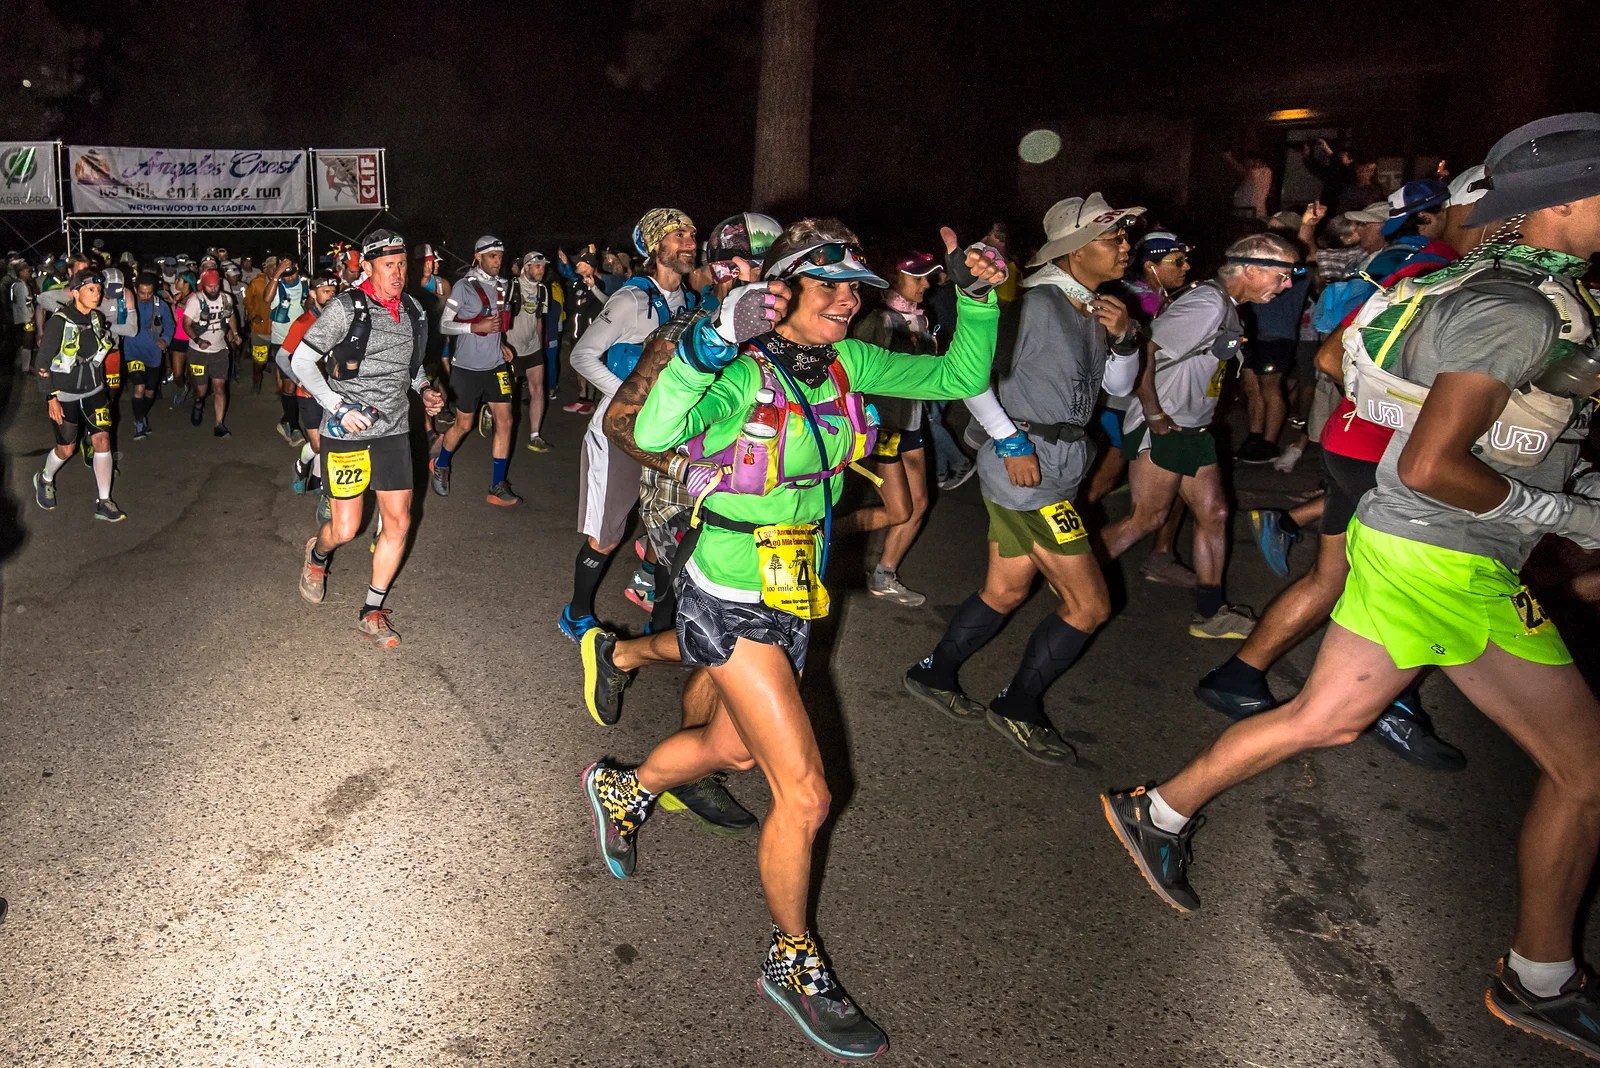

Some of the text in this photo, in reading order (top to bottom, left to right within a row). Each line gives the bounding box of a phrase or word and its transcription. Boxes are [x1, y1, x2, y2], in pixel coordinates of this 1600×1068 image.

[121, 151, 302, 184] Angeles Crest
[360, 158, 376, 199] CLIF
[256, 187, 281, 198] run
[128, 204, 194, 212] WRIGHTWOOD
[335, 468, 363, 485] 222
[1051, 509, 1081, 534] 56
[777, 584, 794, 592] mile
[797, 560, 811, 592] 4
[1515, 591, 1549, 630] 2
